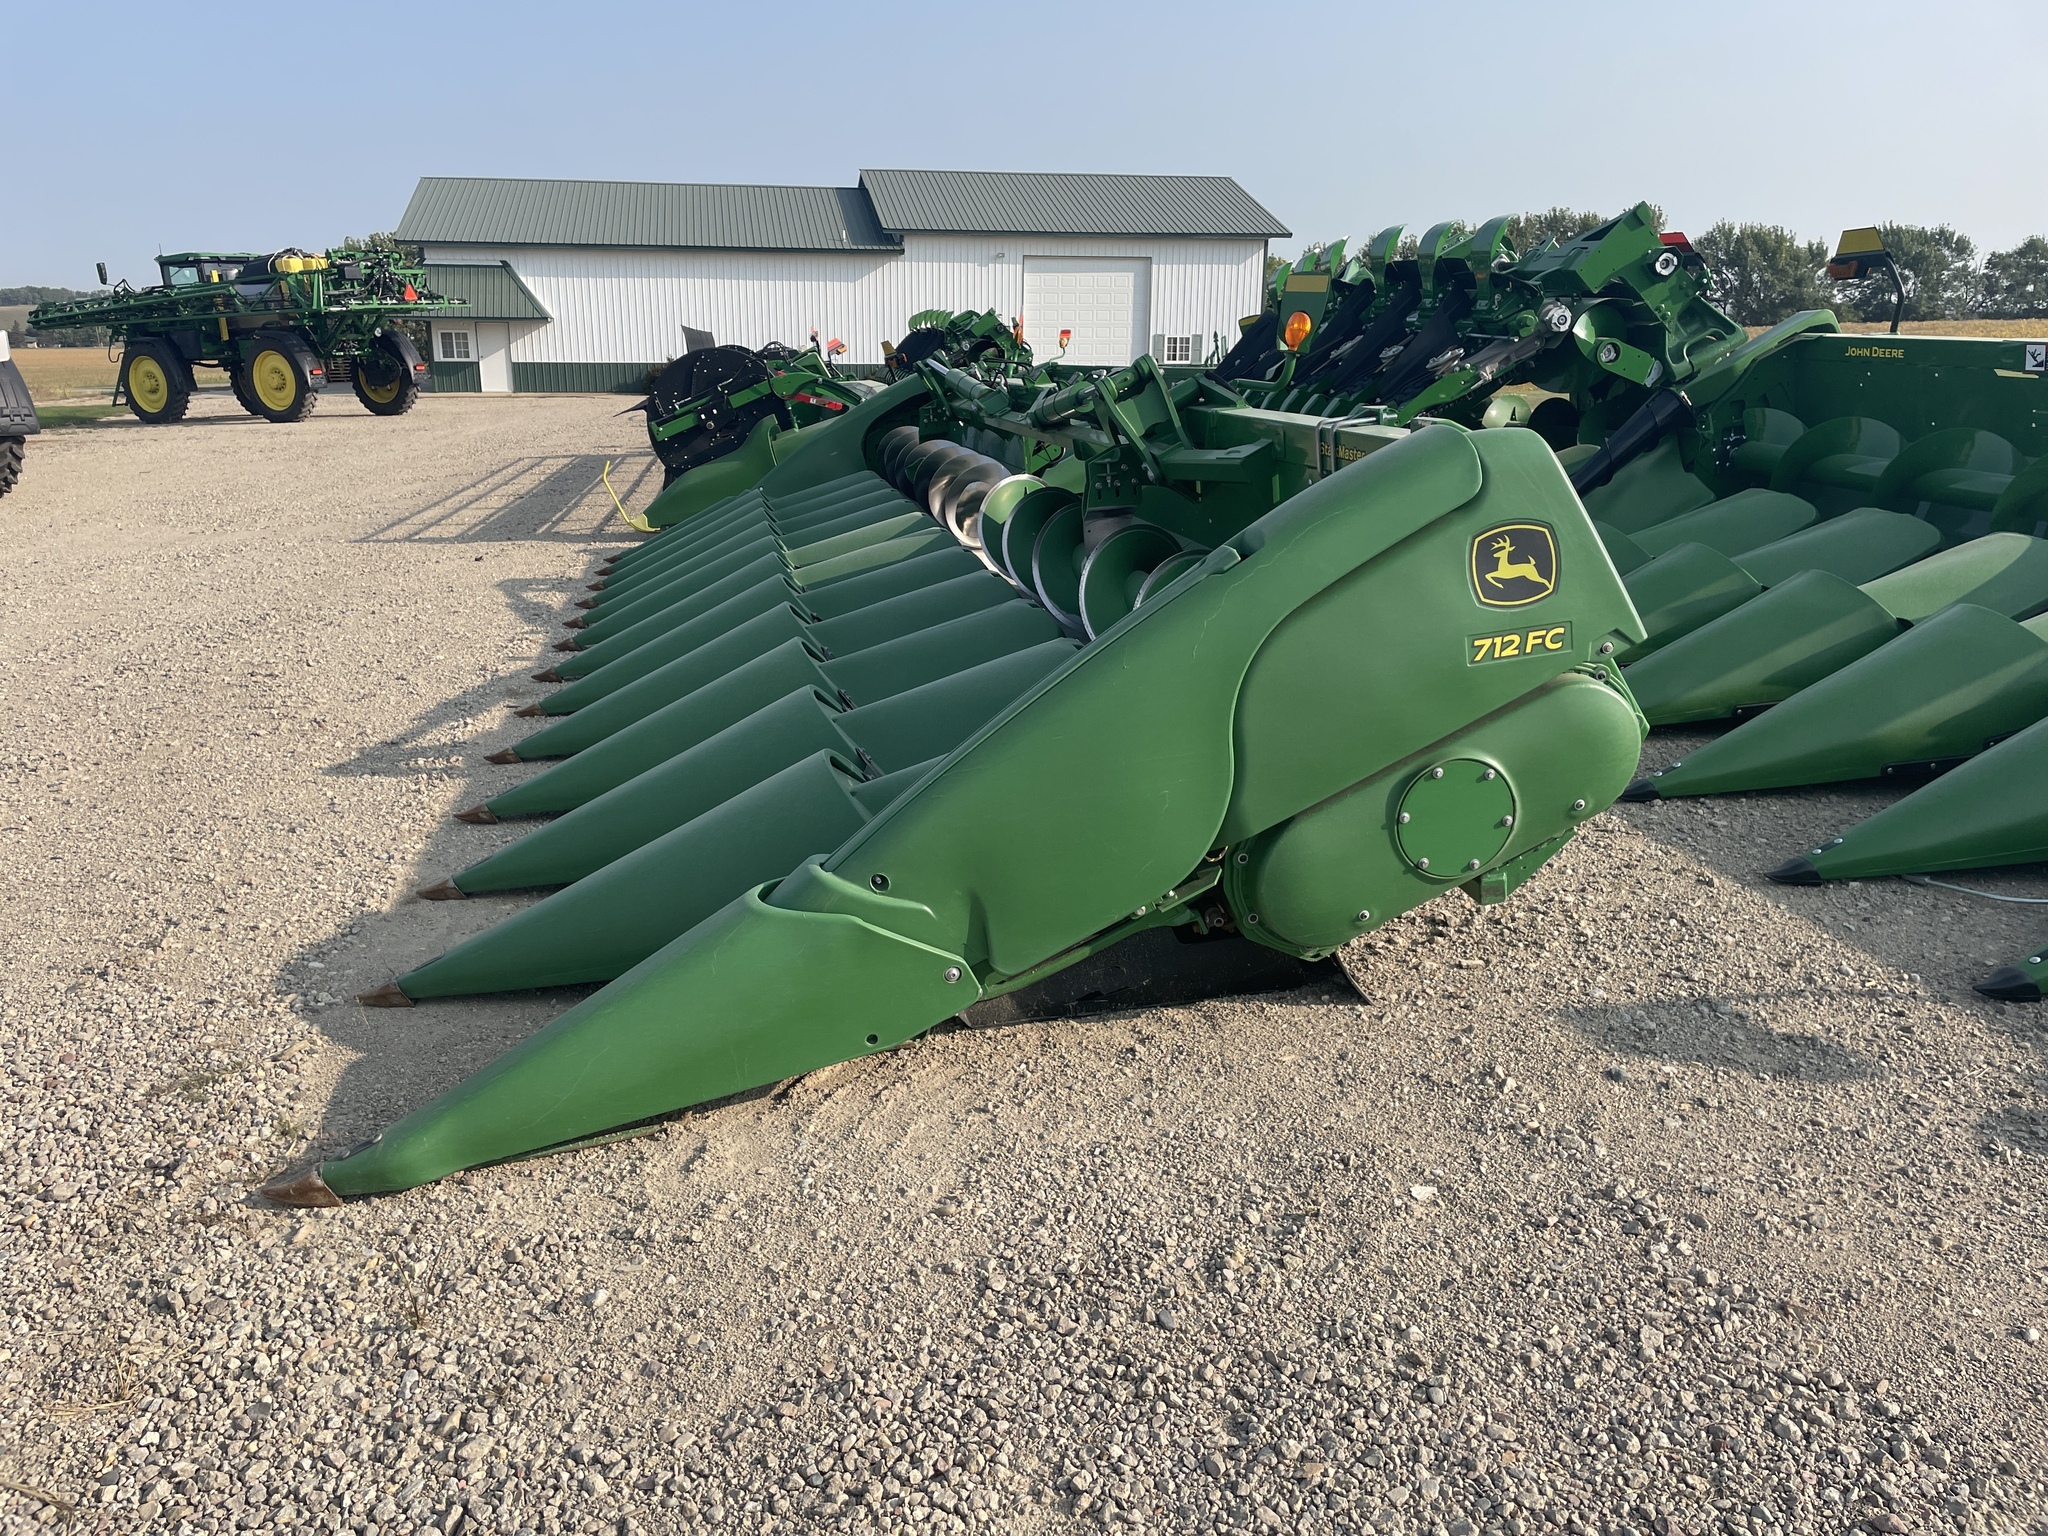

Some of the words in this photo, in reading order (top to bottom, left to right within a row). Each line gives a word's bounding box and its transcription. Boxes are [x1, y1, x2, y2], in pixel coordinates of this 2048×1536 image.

[1845, 346, 1870, 357] JOHN
[1872, 346, 1905, 359] DEERE
[1472, 634, 1521, 662] 712
[1525, 627, 1565, 653] FC
